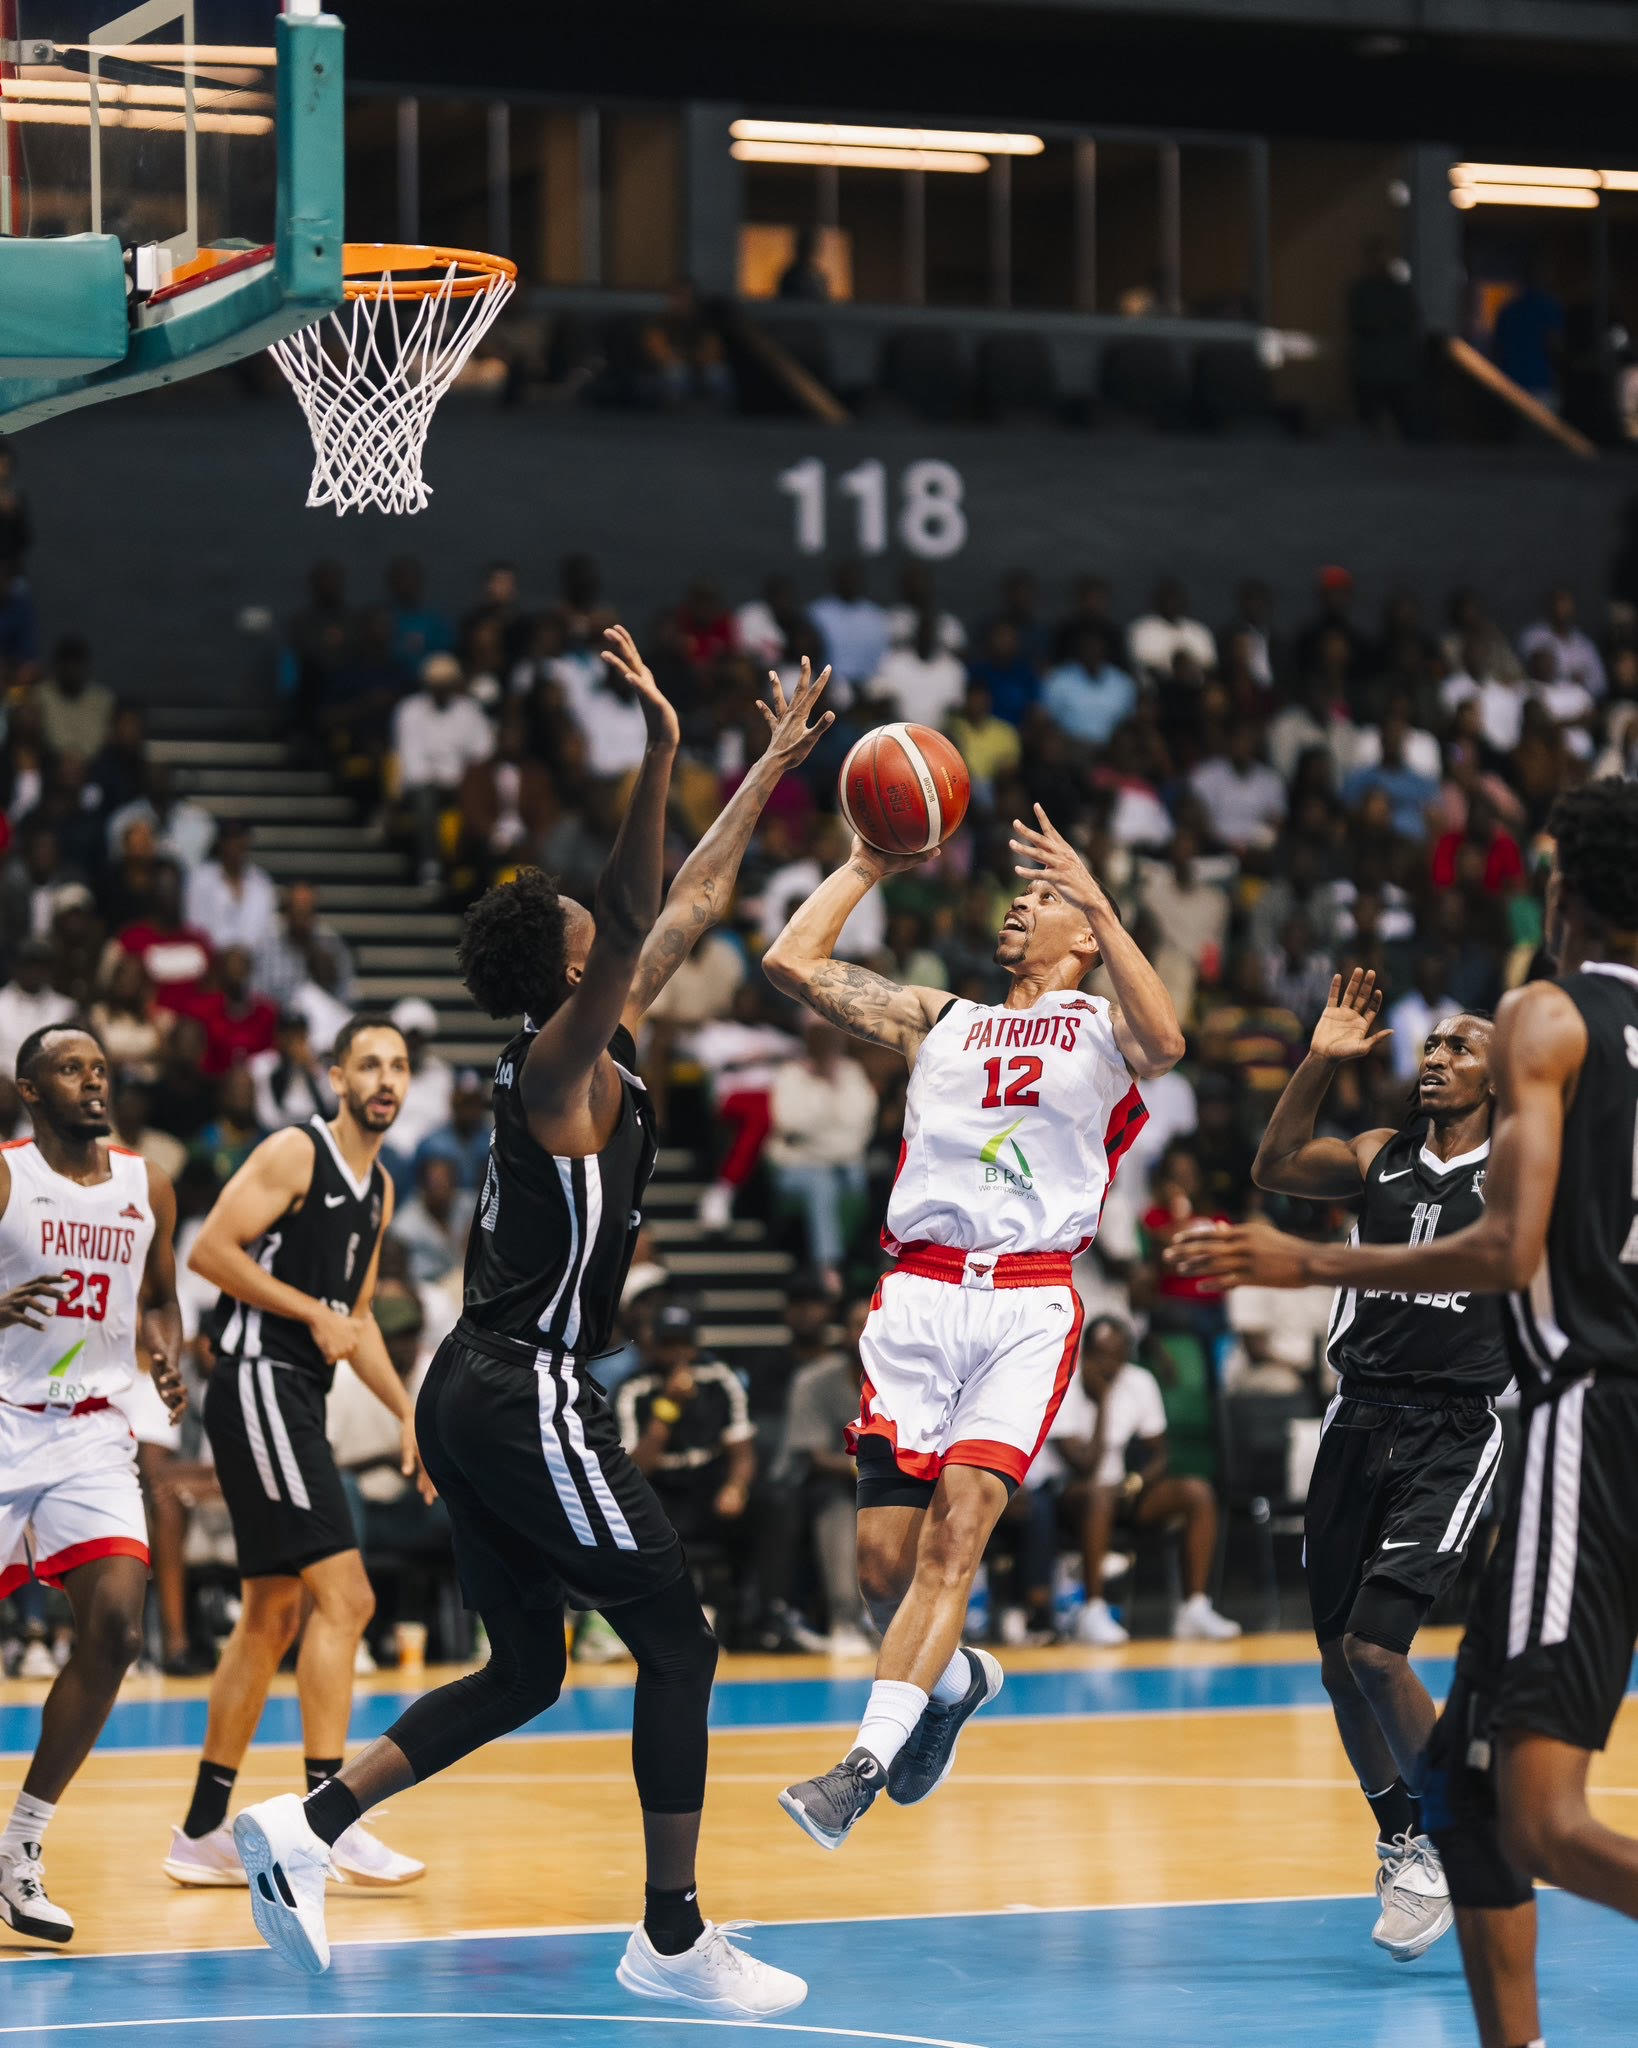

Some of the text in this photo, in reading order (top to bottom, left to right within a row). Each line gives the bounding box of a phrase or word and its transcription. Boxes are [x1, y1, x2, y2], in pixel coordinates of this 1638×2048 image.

[779, 458, 967, 559] 118
[963, 1016, 1080, 1052] PATRIOTS
[981, 1056, 1043, 1108] 12
[992, 1185, 1025, 1197] empower
[1026, 1193, 1039, 1202] you
[41, 1220, 135, 1264] PATRIOTS
[1408, 1202, 1442, 1249] 11
[56, 1269, 110, 1321] 23
